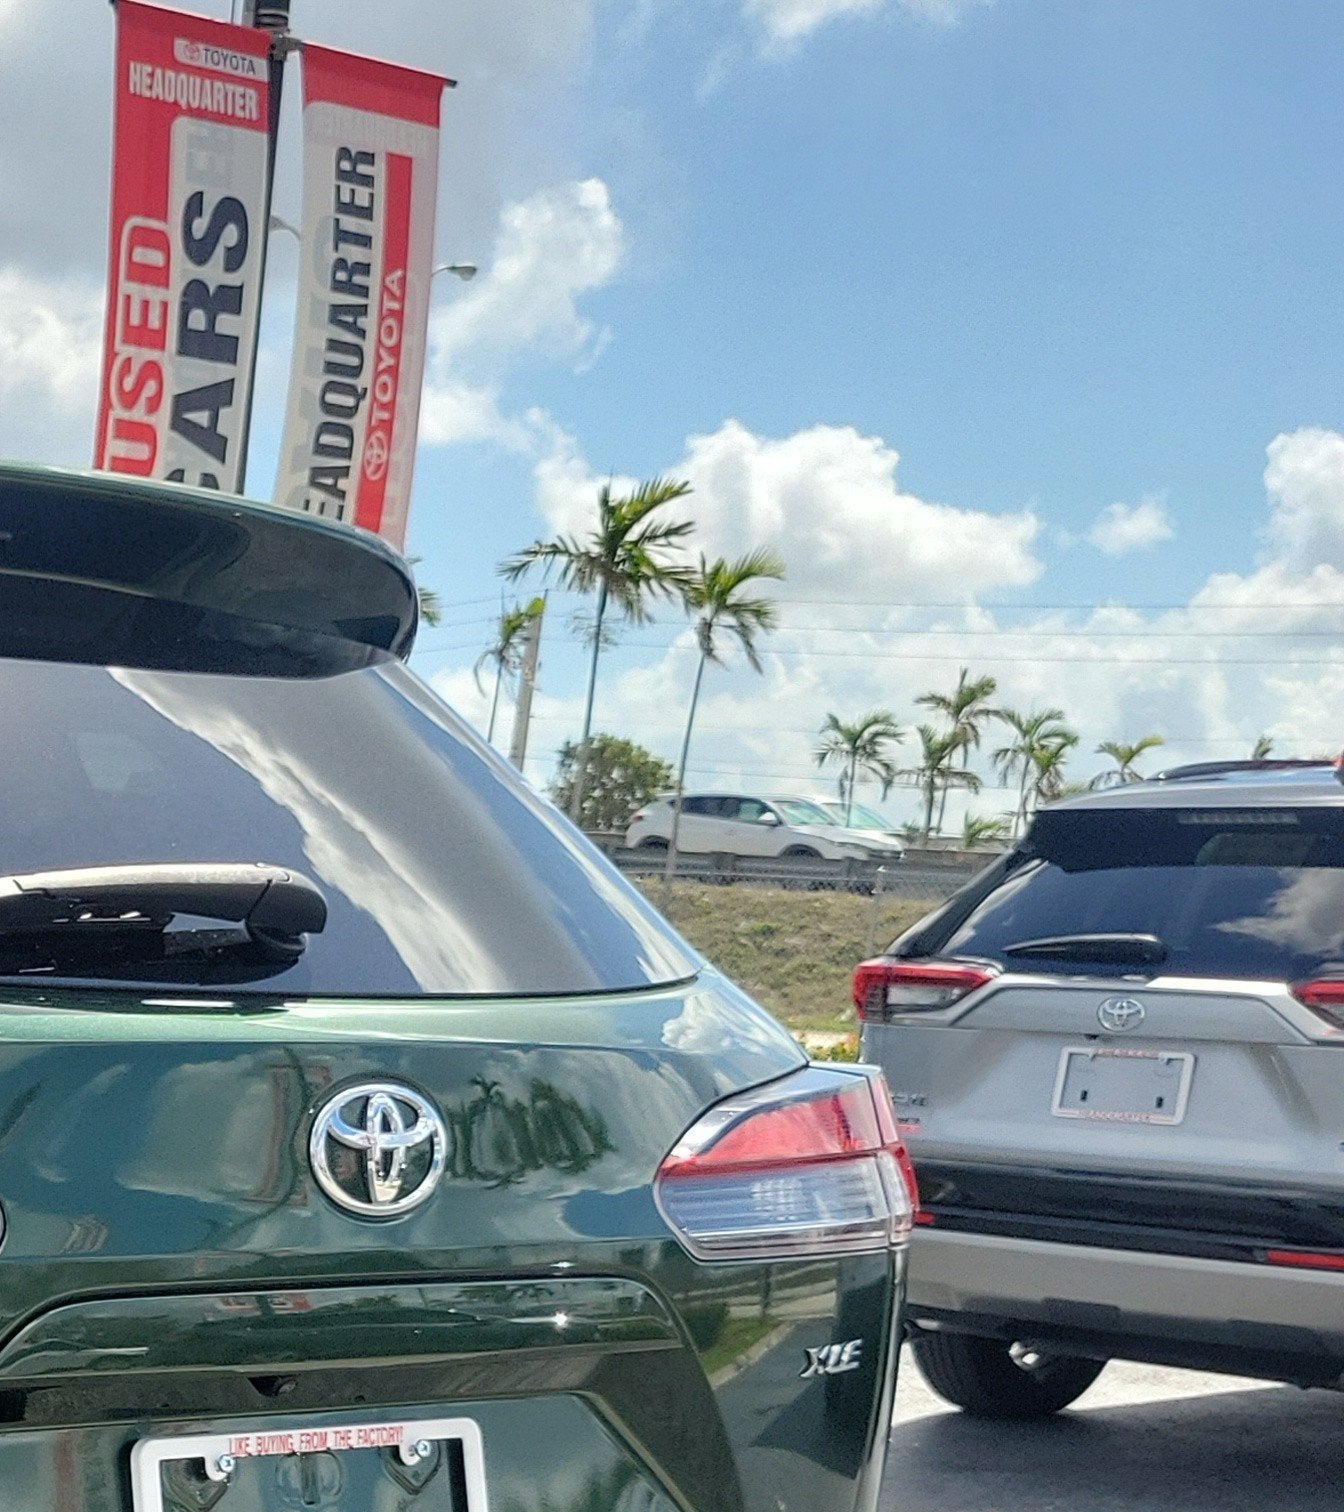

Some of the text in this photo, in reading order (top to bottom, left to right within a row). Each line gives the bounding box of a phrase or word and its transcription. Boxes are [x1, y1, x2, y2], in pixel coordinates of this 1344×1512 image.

[128, 61, 259, 120] HEADQUARTER
[202, 47, 255, 76] TOYOTA
[107, 216, 171, 476] USED
[372, 268, 404, 424] TOYOTA
[229, 1437, 251, 1456] LIKE
[256, 1434, 294, 1454] BUYING
[300, 1431, 328, 1451] FROM
[333, 1429, 353, 1448] THE
